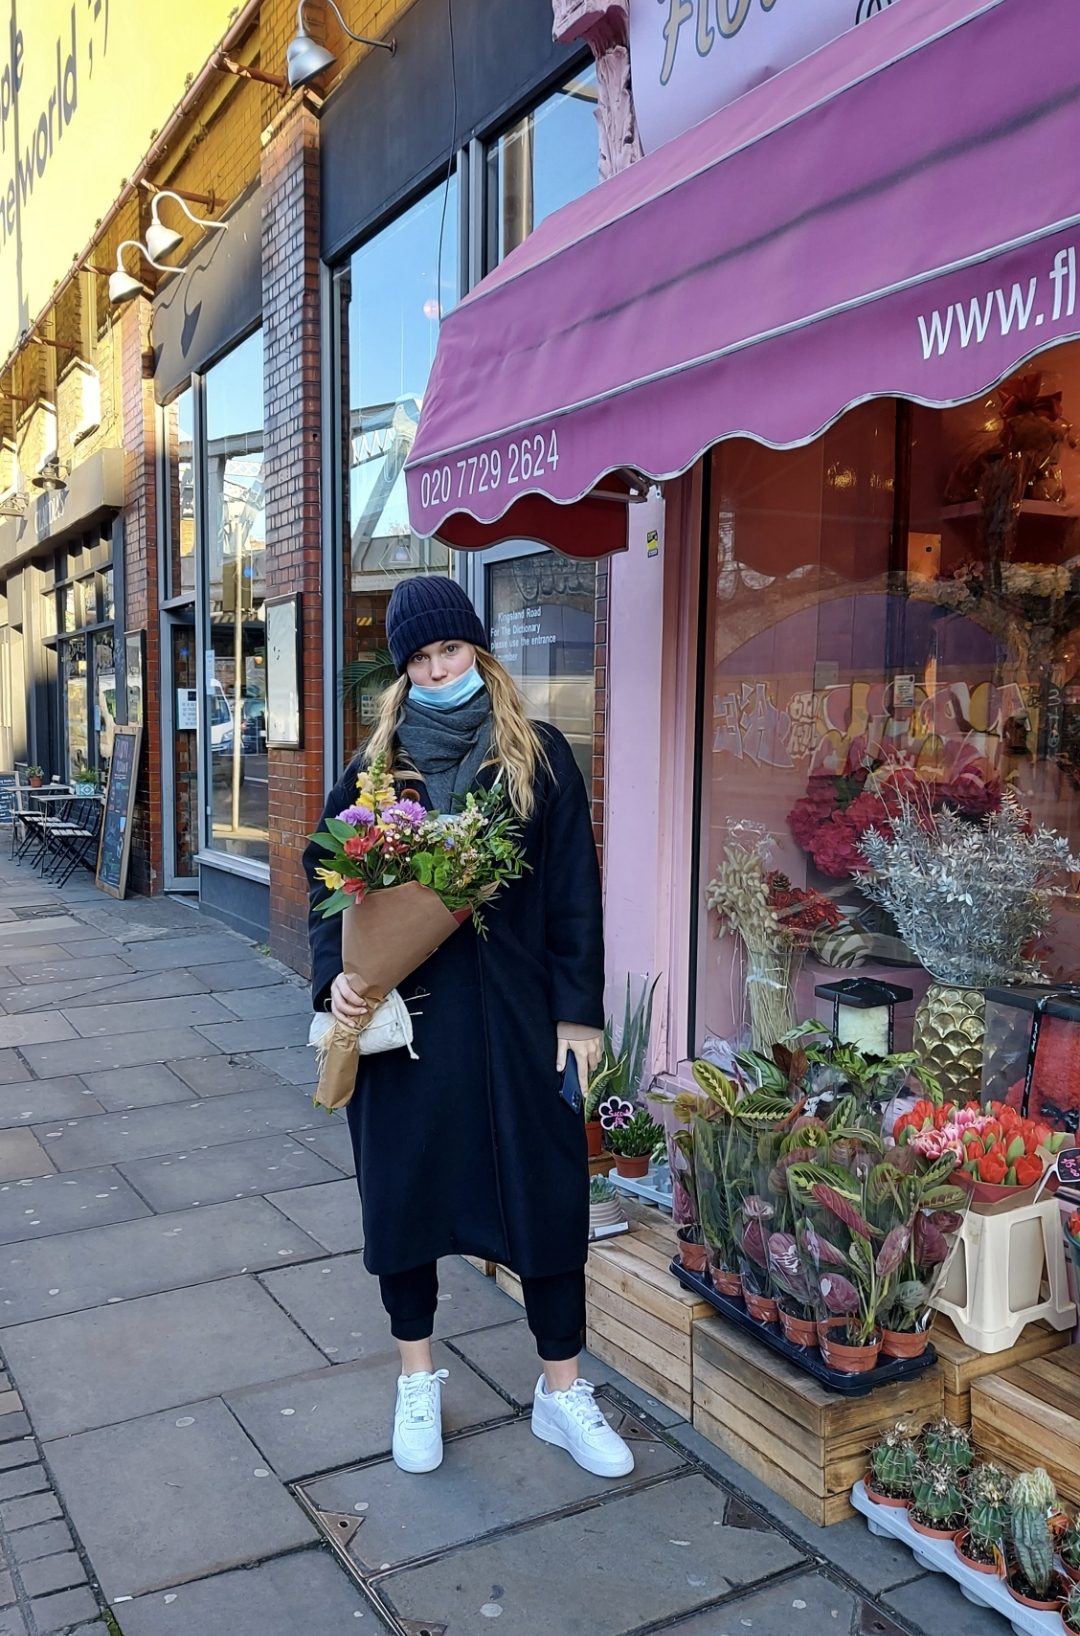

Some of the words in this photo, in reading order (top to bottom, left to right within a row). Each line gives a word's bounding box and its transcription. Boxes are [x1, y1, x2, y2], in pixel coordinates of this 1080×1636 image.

[917, 246, 1076, 360] www.fl
[421, 465, 452, 508] 020
[456, 449, 501, 498] 7729
[507, 429, 559, 484] 2624
[526, 605, 542, 618] Road
[491, 627, 500, 637] For
[502, 626, 511, 636] The
[512, 623, 541, 634] Dictionary
[509, 639, 519, 648] use
[520, 636, 530, 646] the
[531, 634, 556, 646] entrance
